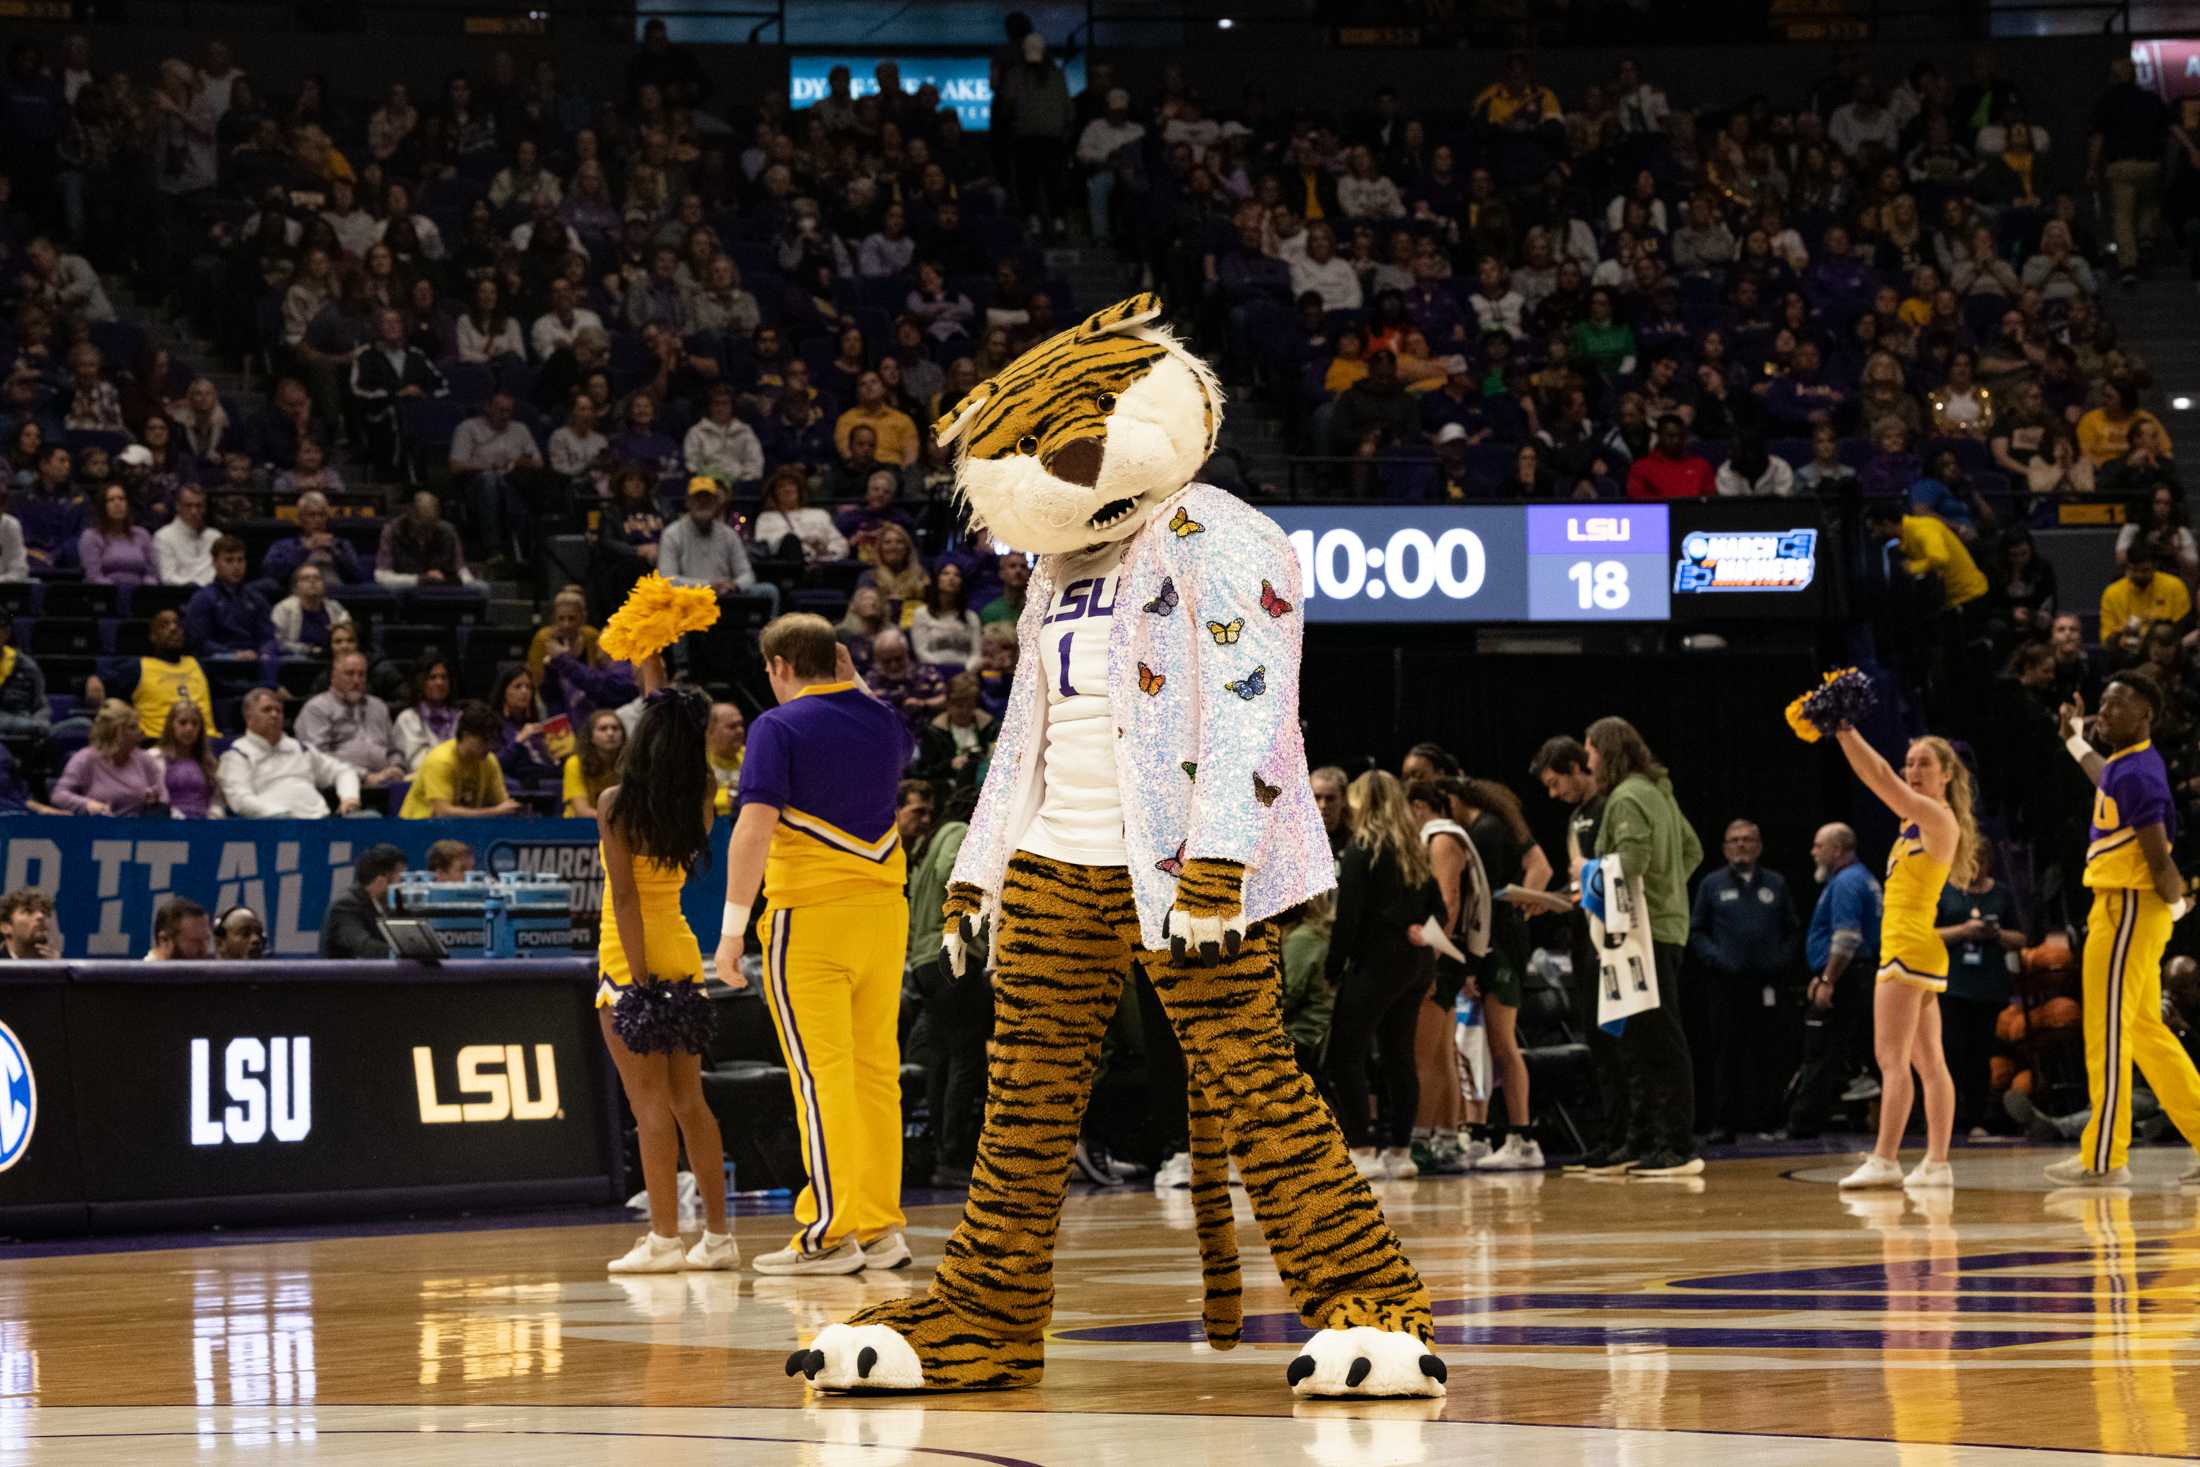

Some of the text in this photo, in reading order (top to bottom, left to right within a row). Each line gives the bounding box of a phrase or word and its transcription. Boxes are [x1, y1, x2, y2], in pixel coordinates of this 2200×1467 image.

[1288, 528, 1486, 599] 10:00
[1567, 518, 1631, 542] LSU
[1043, 576, 1121, 625] SU
[1568, 560, 1631, 610] 18
[1058, 631, 1080, 697] 1
[88, 840, 190, 955] IT
[191, 1036, 311, 1145] LSU
[413, 1043, 560, 1124] LSU
